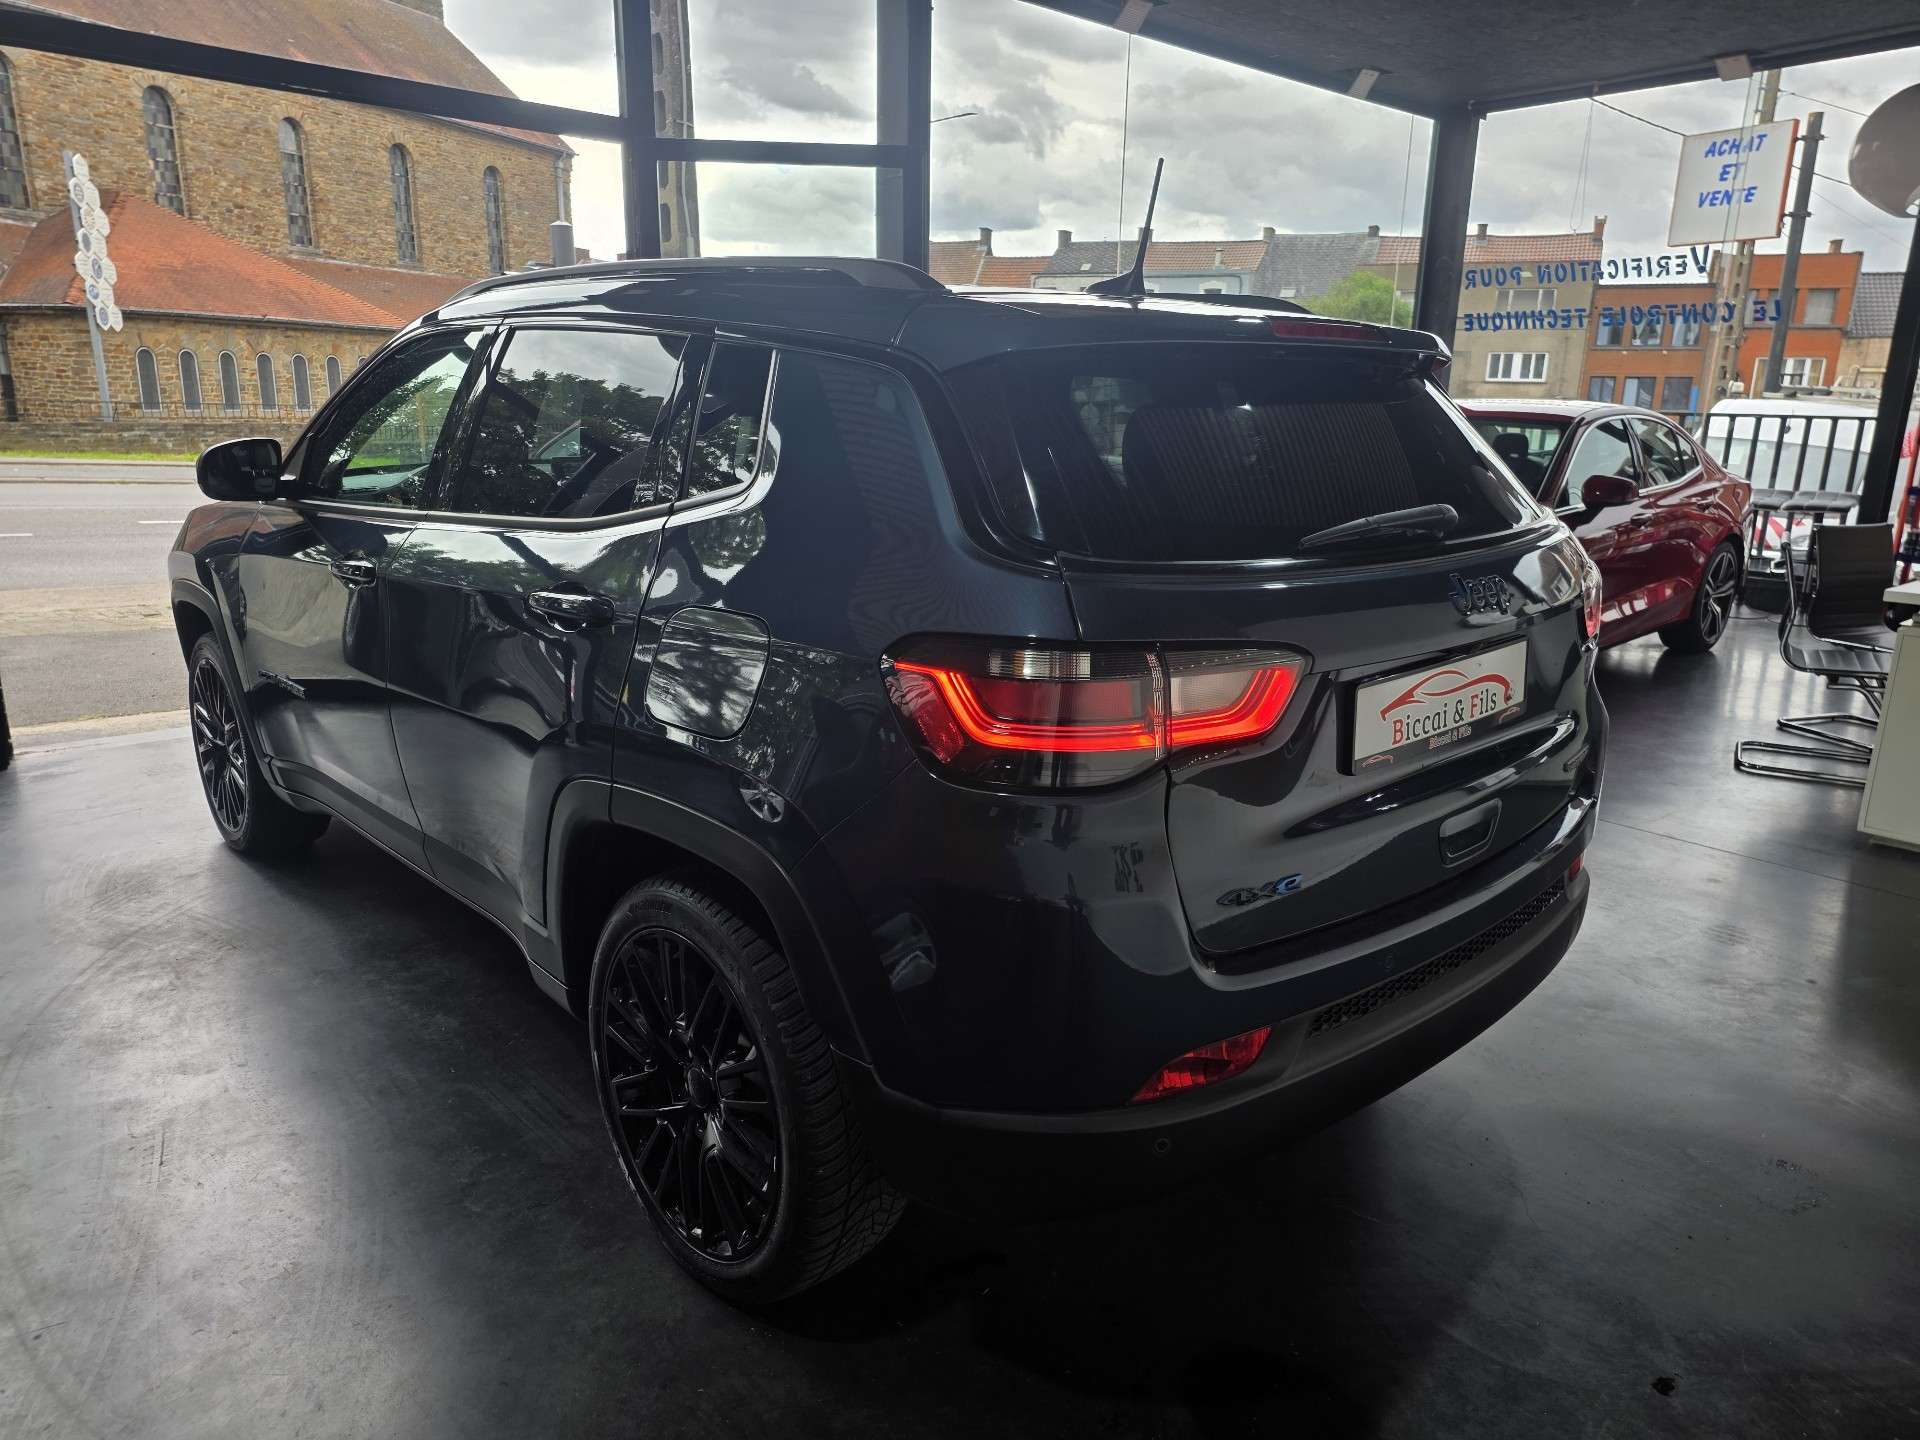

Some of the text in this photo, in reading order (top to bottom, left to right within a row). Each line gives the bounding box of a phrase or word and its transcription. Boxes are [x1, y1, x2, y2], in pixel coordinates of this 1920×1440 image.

[1704, 133, 1768, 158] ACHAT
[1718, 162, 1746, 182] ET
[1698, 186, 1758, 208] VENTE
[1448, 573, 1514, 616] Jeep
[1391, 688, 1498, 746] Biccai & Fils
